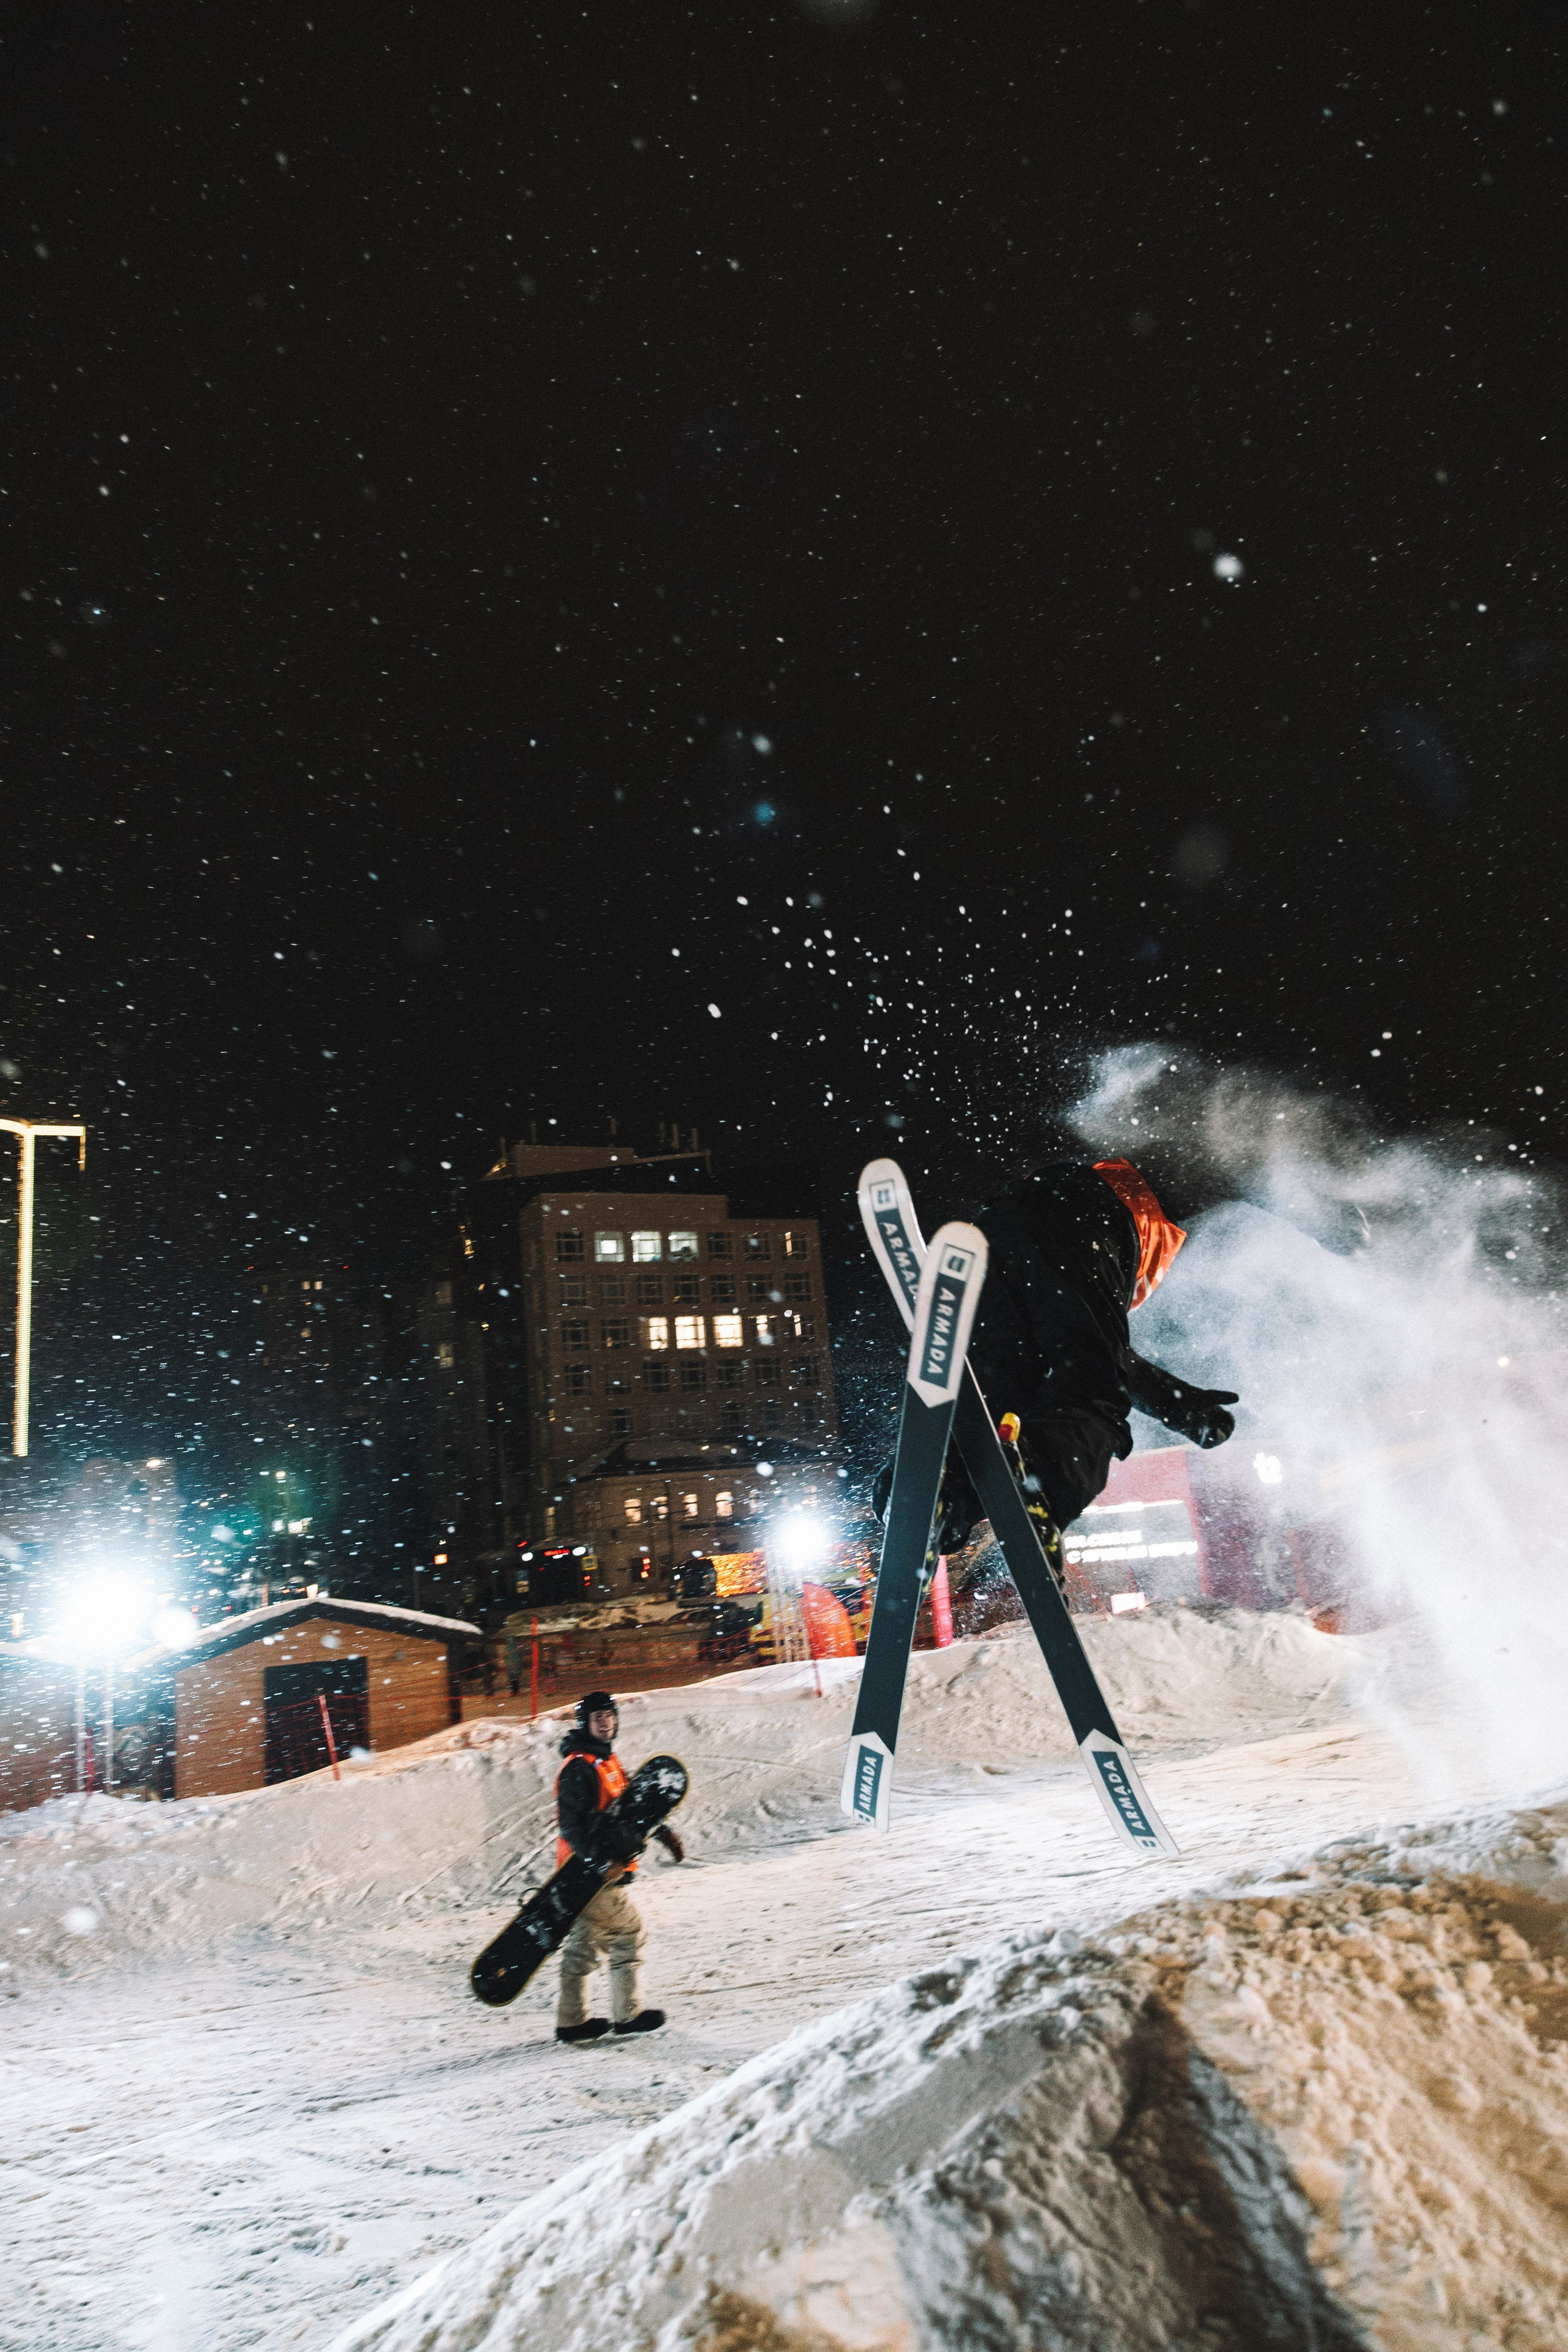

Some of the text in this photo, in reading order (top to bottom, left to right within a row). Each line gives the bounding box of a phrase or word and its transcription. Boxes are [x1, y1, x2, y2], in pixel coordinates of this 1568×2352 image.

[883, 1222, 920, 1303] ARMAD
[927, 1287, 956, 1374] ARMADA
[859, 1756, 877, 1811] ARMADA
[1103, 1760, 1146, 1830] ARMADA
